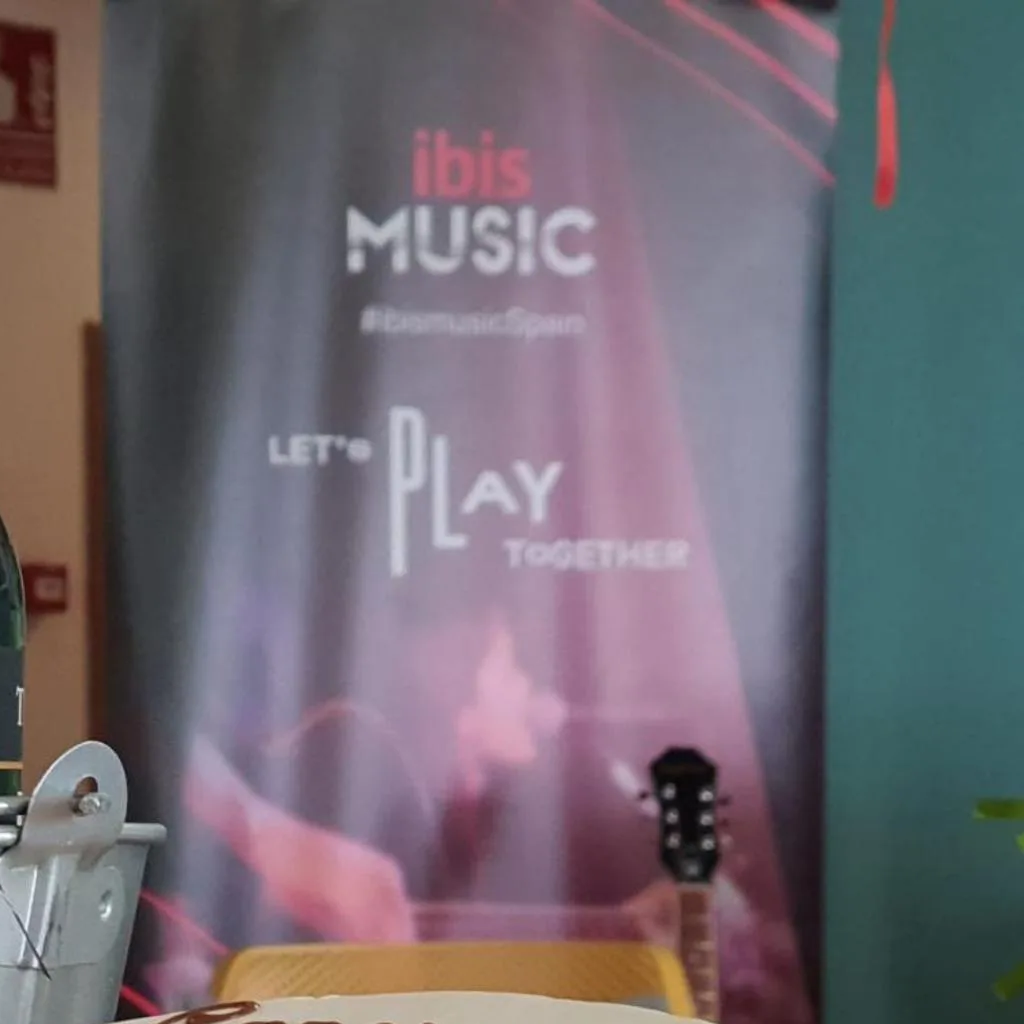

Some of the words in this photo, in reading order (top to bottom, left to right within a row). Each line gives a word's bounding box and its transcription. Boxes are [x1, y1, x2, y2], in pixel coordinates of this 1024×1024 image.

[411, 128, 533, 199] ibis
[345, 203, 598, 277] MUSIC
[388, 405, 564, 577] PLAY
